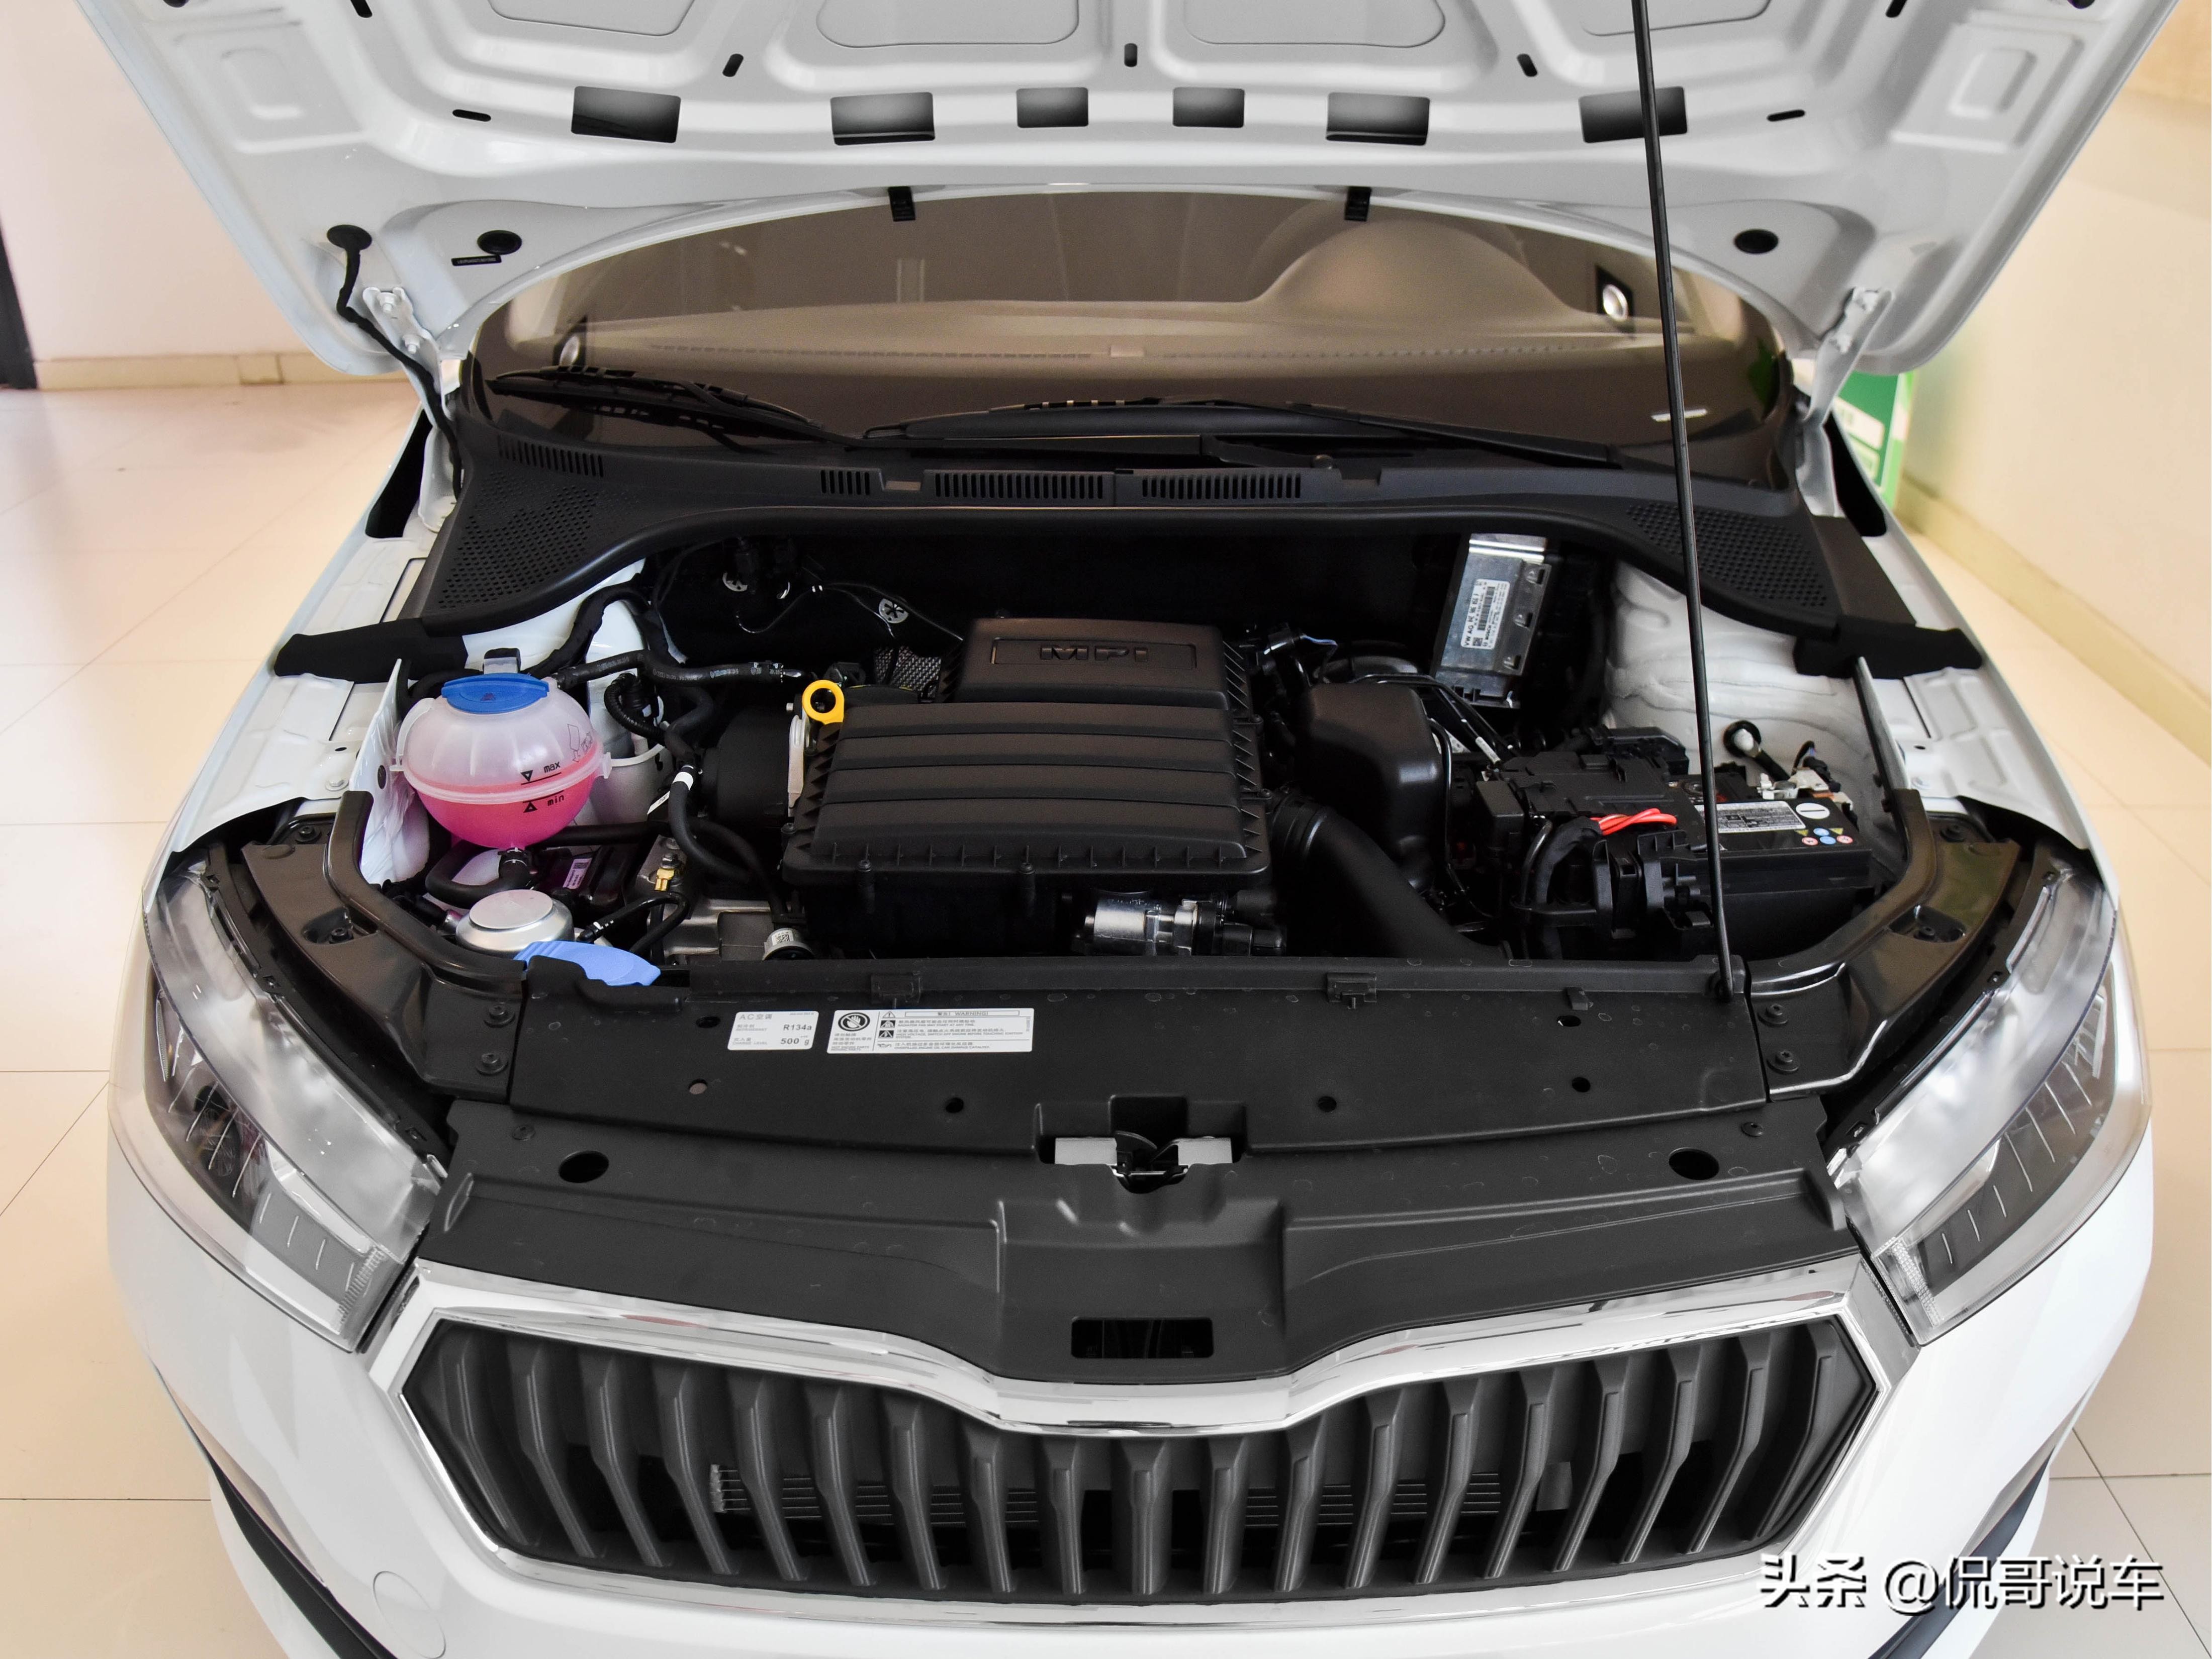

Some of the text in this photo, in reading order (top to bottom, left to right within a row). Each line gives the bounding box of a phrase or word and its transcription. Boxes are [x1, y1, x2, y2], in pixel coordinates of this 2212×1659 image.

[1040, 644, 1149, 663] MPI
[543, 761, 561, 773] max
[547, 794, 565, 806] min
